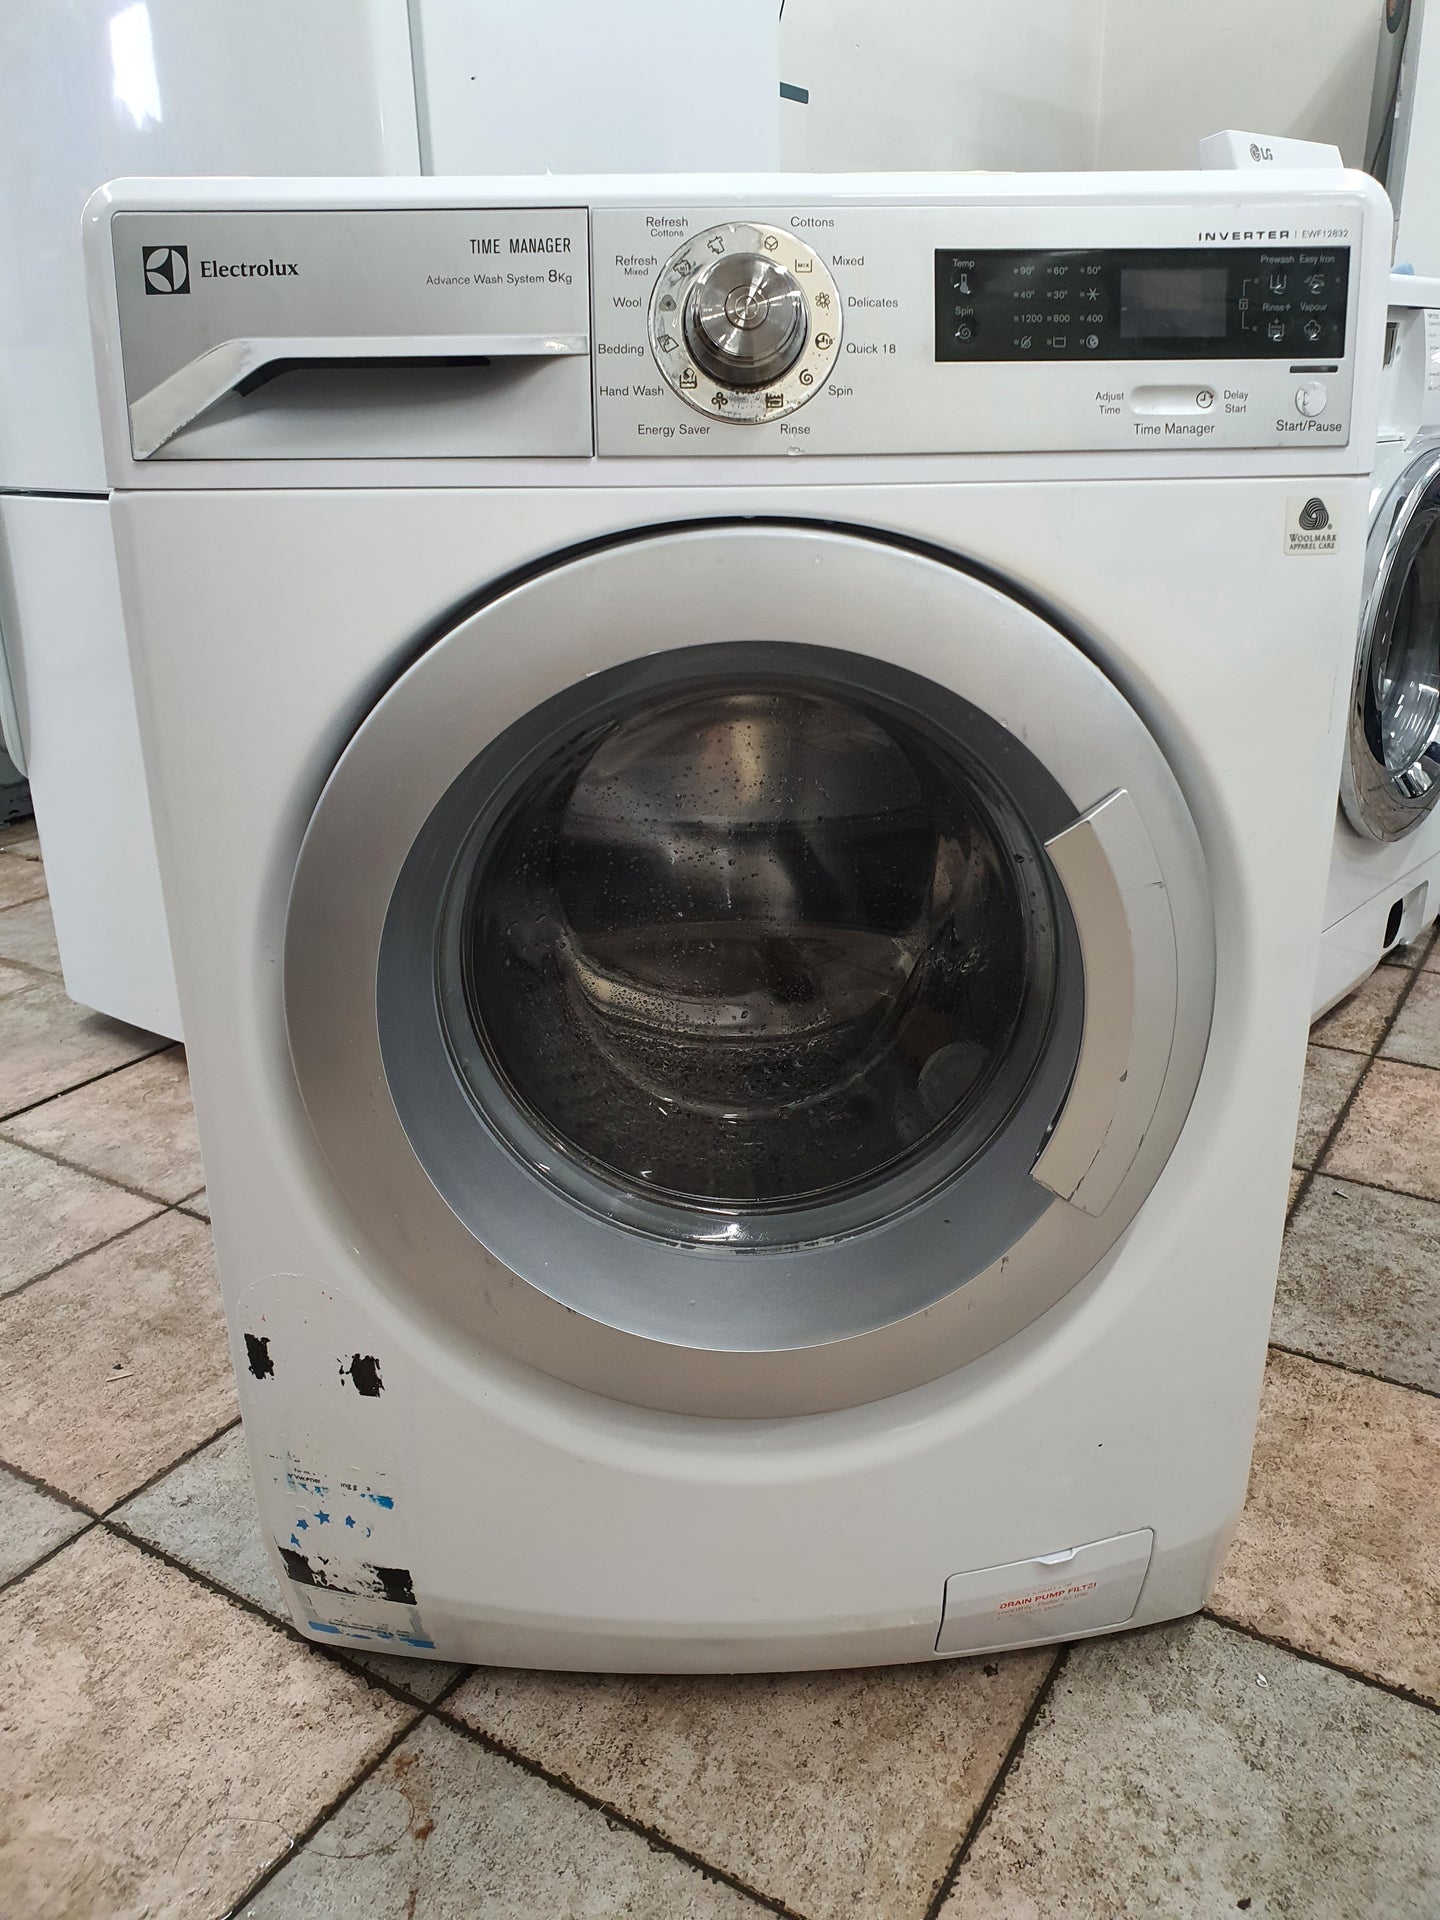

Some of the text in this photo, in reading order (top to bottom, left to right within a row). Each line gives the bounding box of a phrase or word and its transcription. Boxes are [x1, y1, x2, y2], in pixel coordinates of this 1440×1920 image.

[1260, 147, 1274, 161] LG
[646, 216, 689, 228] Refresh
[790, 216, 835, 228] Cottons
[650, 229, 684, 237] Cottons
[1197, 230, 1290, 241] INVERTER
[469, 237, 572, 255] TIME MANAGER
[615, 255, 658, 267] Refresh
[832, 255, 865, 267] Mixed
[953, 258, 975, 269] Temp
[1260, 254, 1295, 264] Prewash
[1299, 254, 1318, 265] Easy
[200, 259, 300, 279] Electrolux
[624, 267, 649, 277] Mixed
[425, 269, 573, 287] Advance Wash System 8Kg
[612, 296, 642, 308] Wool
[847, 296, 899, 308] Delicates
[1299, 302, 1328, 313] Vapour
[954, 306, 974, 318] Spin
[1021, 312, 1104, 323] 1200 800 400
[598, 343, 645, 357] Bedding
[845, 342, 896, 355] Quick 18
[599, 385, 664, 397] Hand Wash
[828, 385, 853, 398] Spin
[1095, 390, 1125, 404] Adjust
[1223, 389, 1249, 402] Delay
[1099, 405, 1121, 415] Time
[1225, 403, 1247, 415] Start
[637, 424, 711, 437] Energy Saver
[780, 424, 811, 435] Rinse
[1133, 422, 1215, 437] Time Manager
[1275, 420, 1343, 434] Start/Pause
[999, 1597, 1032, 1610] DRAIN
[1034, 1590, 1066, 1602] PUMP
